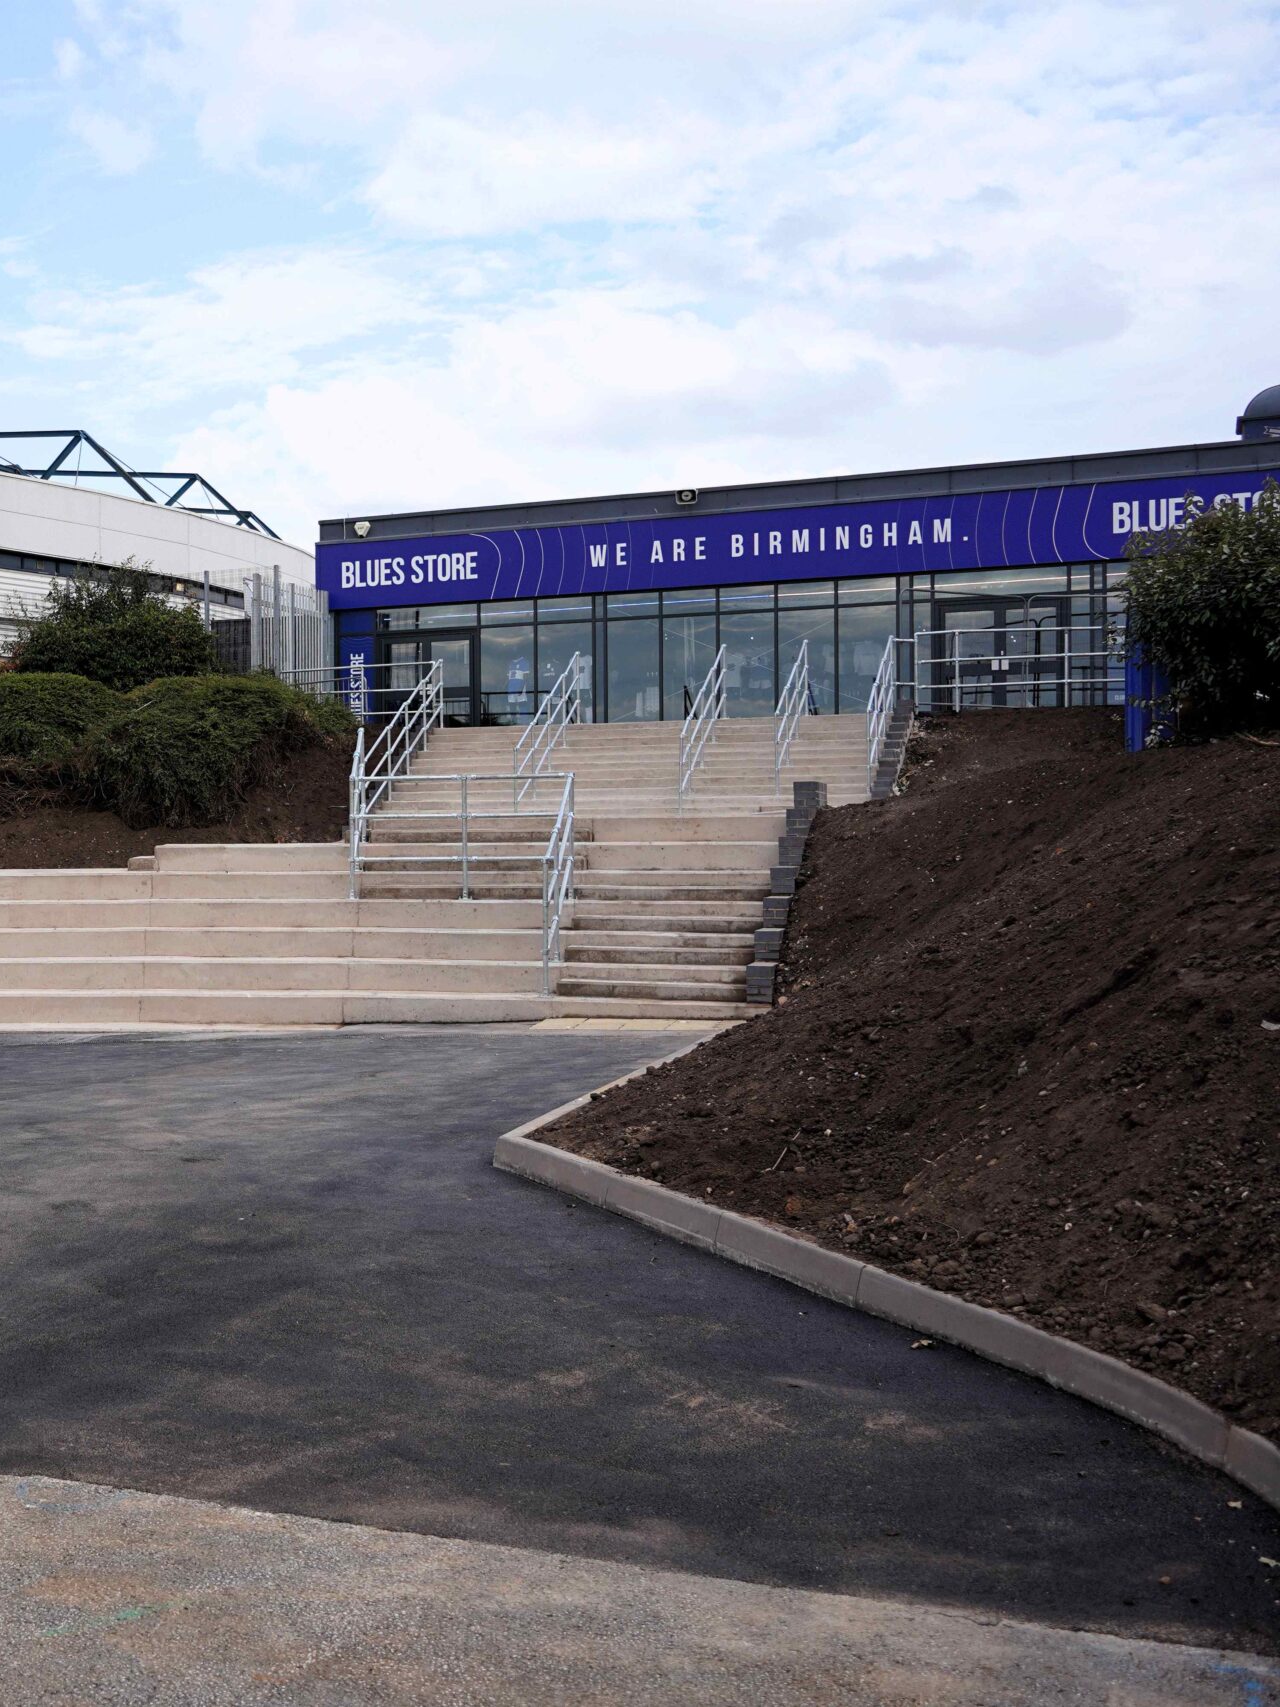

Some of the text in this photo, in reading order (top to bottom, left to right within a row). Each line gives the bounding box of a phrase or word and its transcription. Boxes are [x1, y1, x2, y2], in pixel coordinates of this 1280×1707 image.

[589, 518, 969, 568] WE ARE BIRMINGHAM.
[341, 551, 479, 589] BLUES STORE
